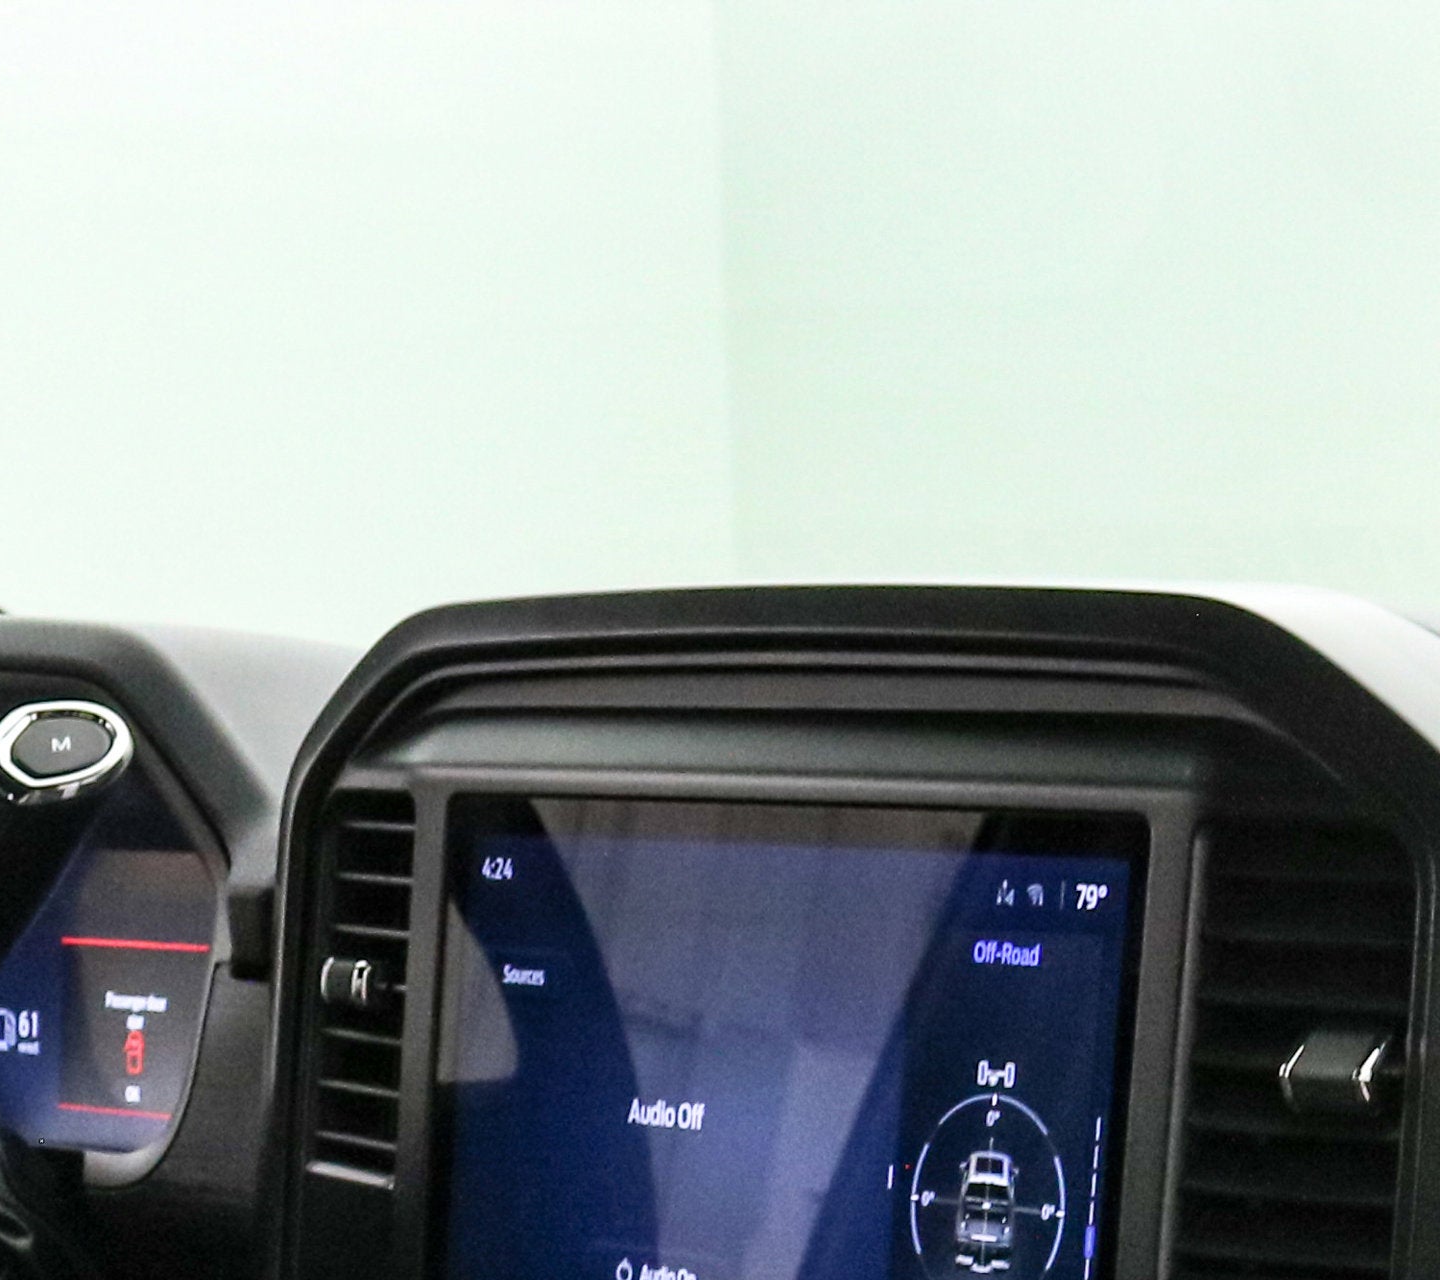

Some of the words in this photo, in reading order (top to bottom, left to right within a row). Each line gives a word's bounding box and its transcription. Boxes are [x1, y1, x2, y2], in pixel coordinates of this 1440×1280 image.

[51, 736, 72, 753] M
[482, 857, 514, 880] 4:24
[973, 939, 1043, 967] Off-Road
[502, 964, 546, 986] Sources
[17, 1009, 39, 1039] 61
[627, 1097, 677, 1129] Audio
[677, 1101, 706, 1131] Off
